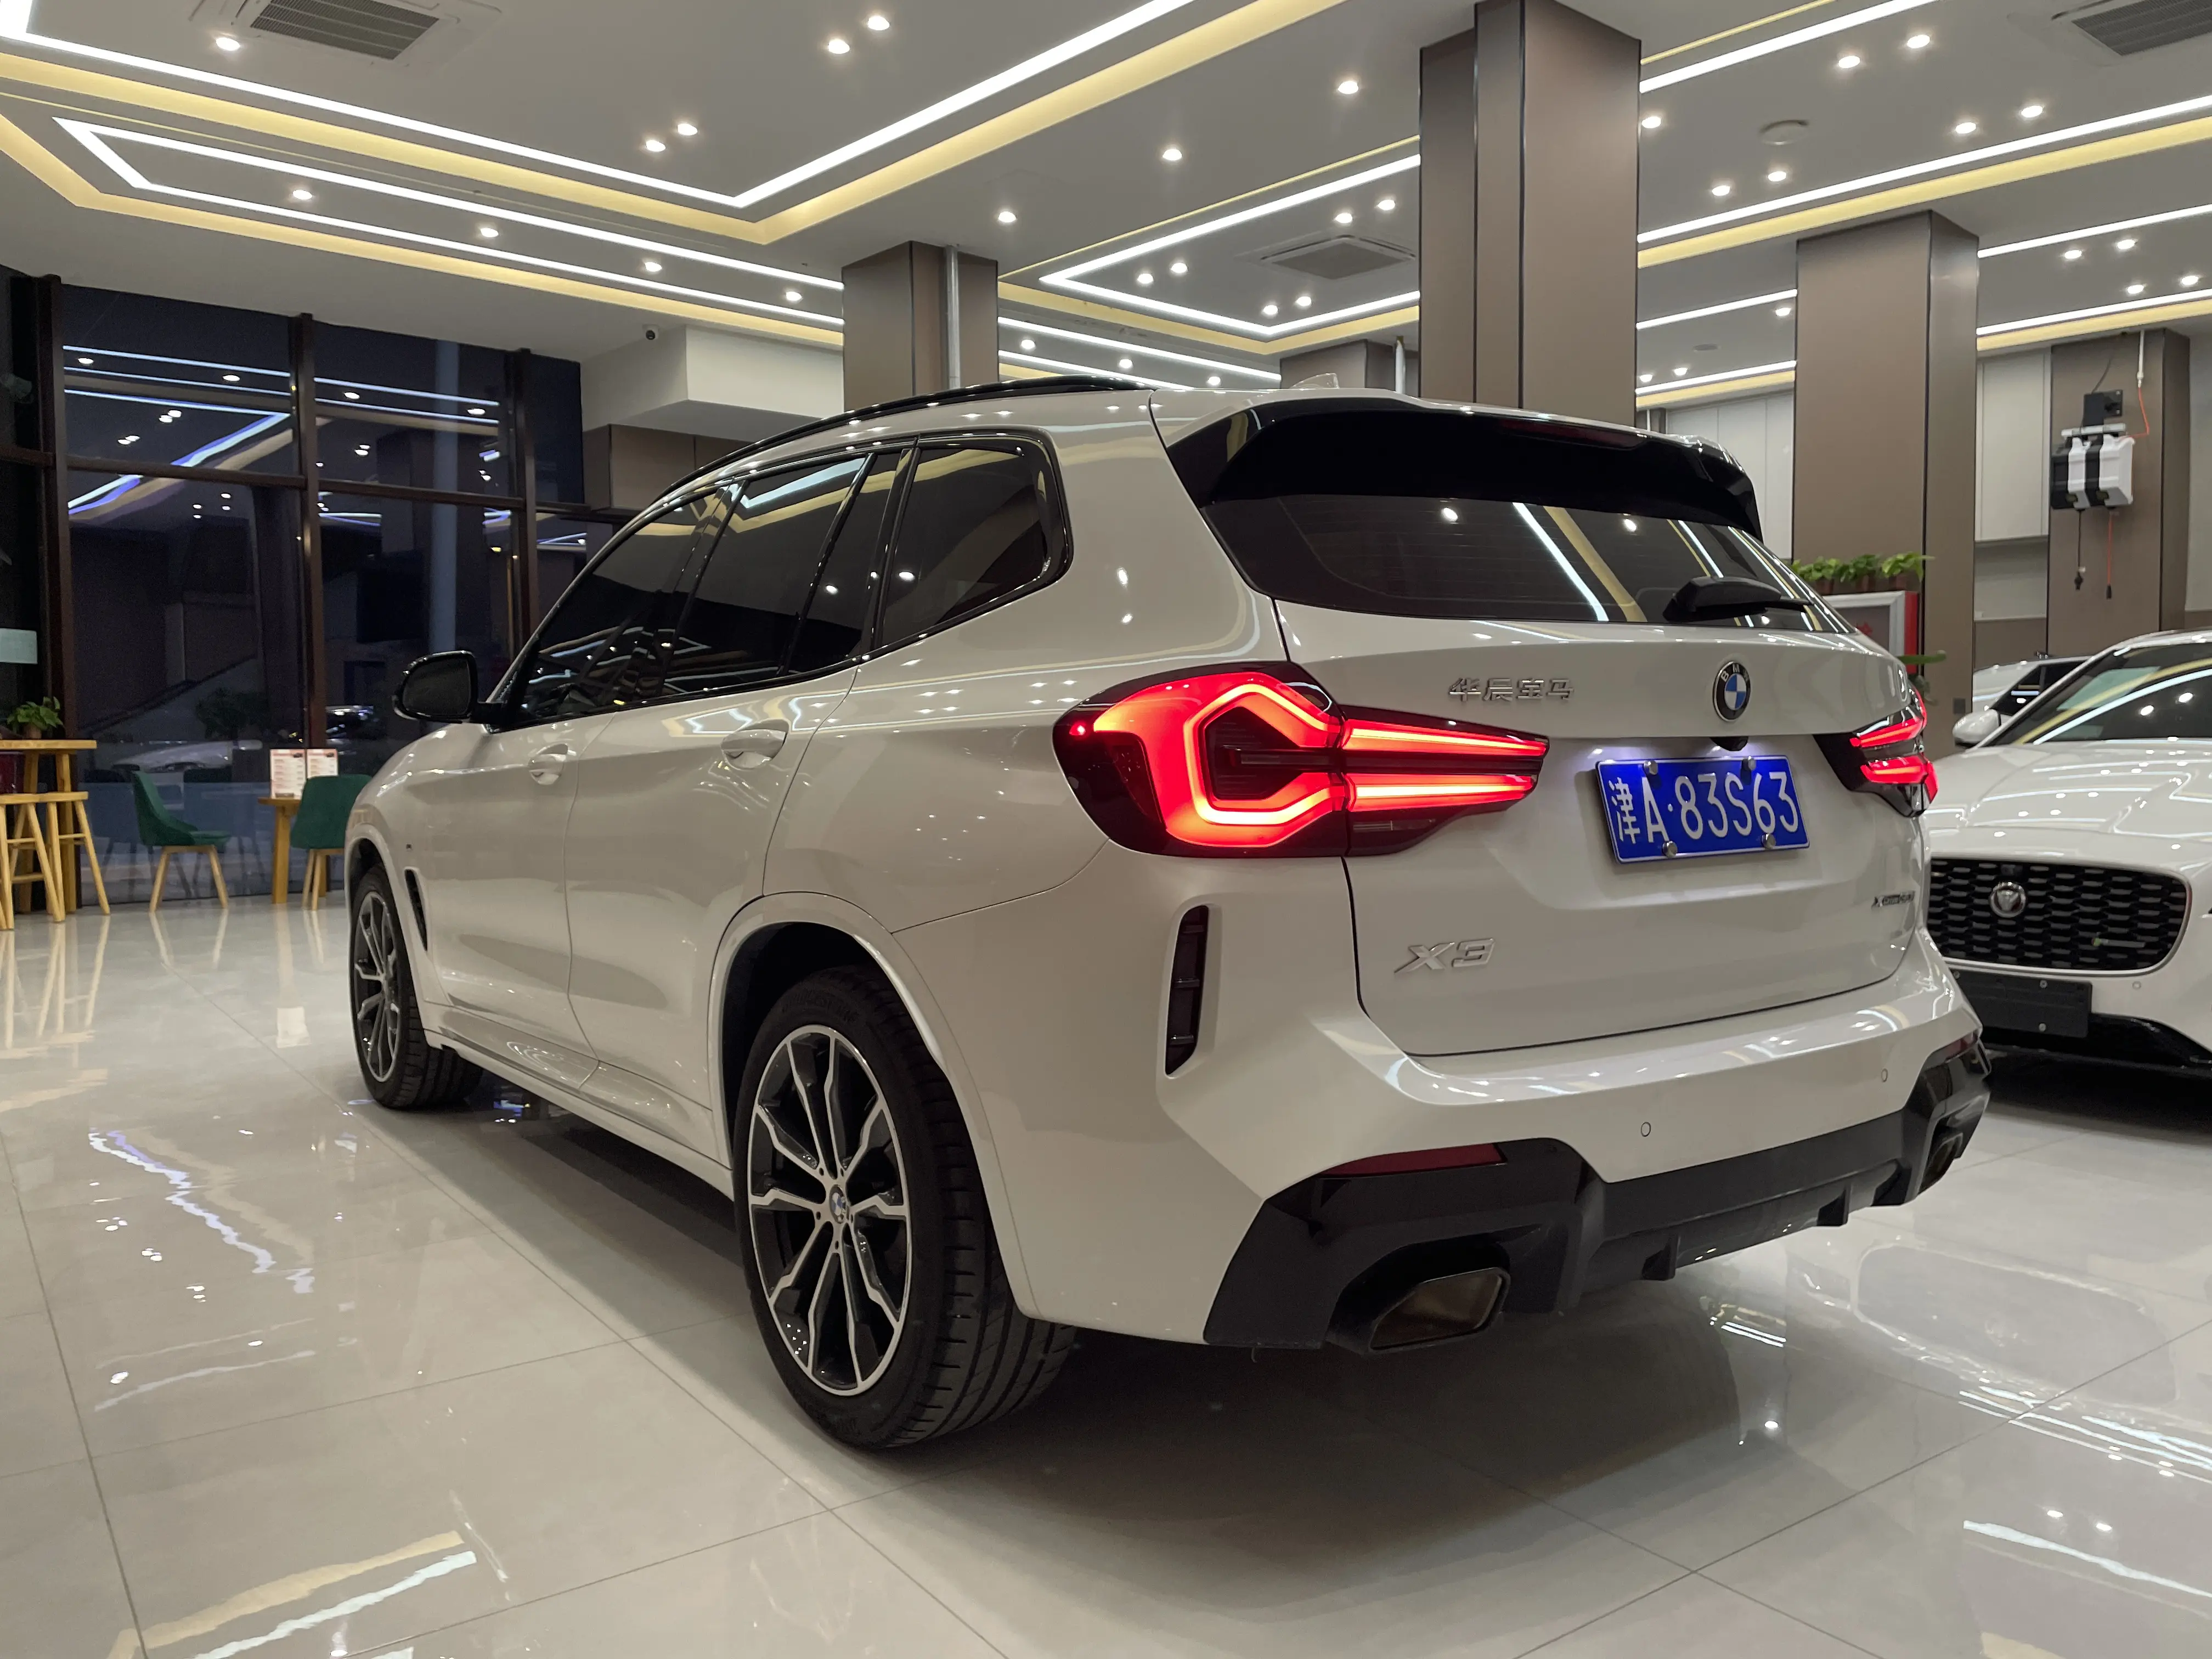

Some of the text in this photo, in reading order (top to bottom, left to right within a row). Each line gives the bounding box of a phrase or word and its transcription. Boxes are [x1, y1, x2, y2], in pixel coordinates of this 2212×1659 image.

[1720, 663, 1750, 682] BMW
[1449, 678, 1574, 702] 华晨宝马
[1394, 938, 1496, 974] X3
